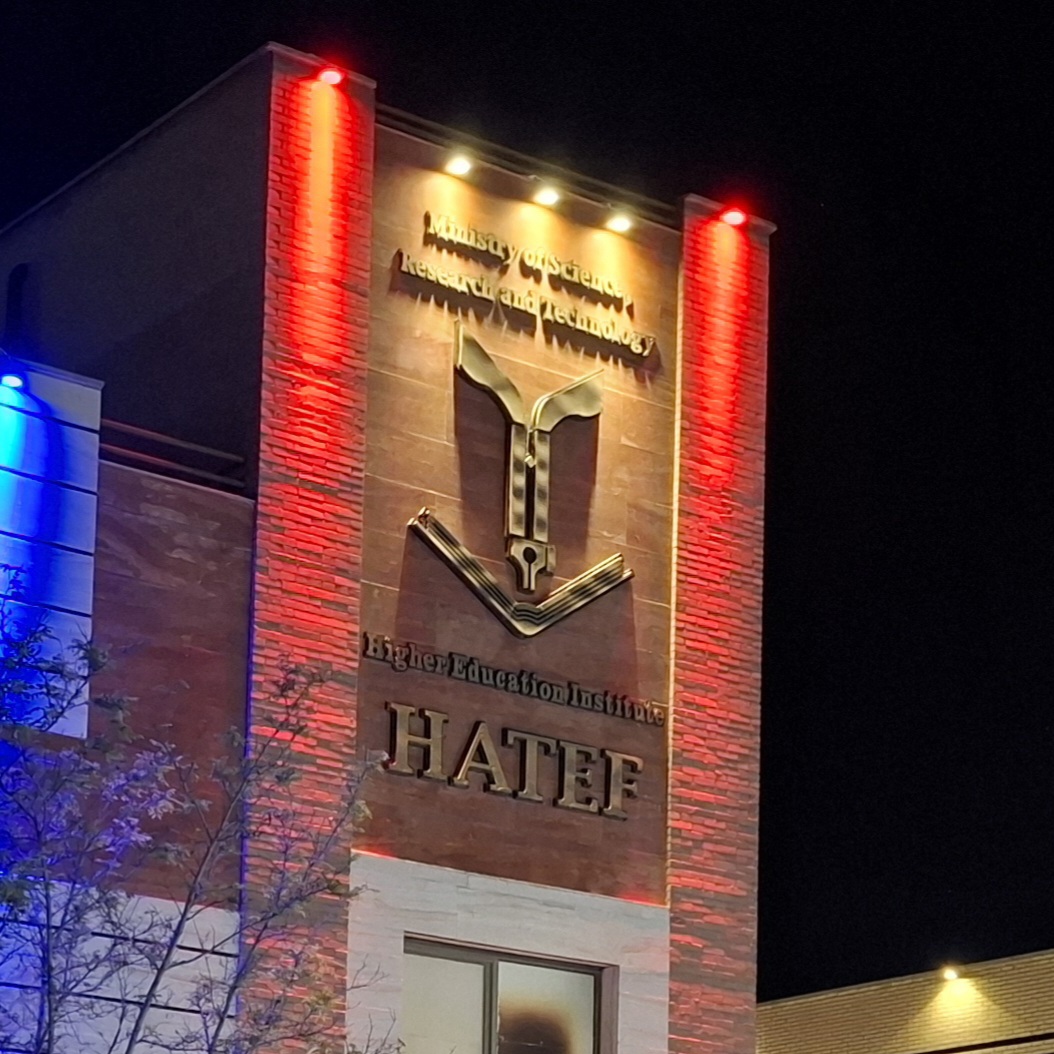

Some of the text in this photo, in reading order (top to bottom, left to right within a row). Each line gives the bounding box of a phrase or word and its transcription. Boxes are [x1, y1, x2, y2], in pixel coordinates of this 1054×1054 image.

[429, 212, 520, 265] Ministry
[523, 247, 545, 270] of
[401, 252, 656, 356] Research and Technology
[364, 632, 666, 728] Higher Education Institute
[386, 701, 645, 820] HATEF
